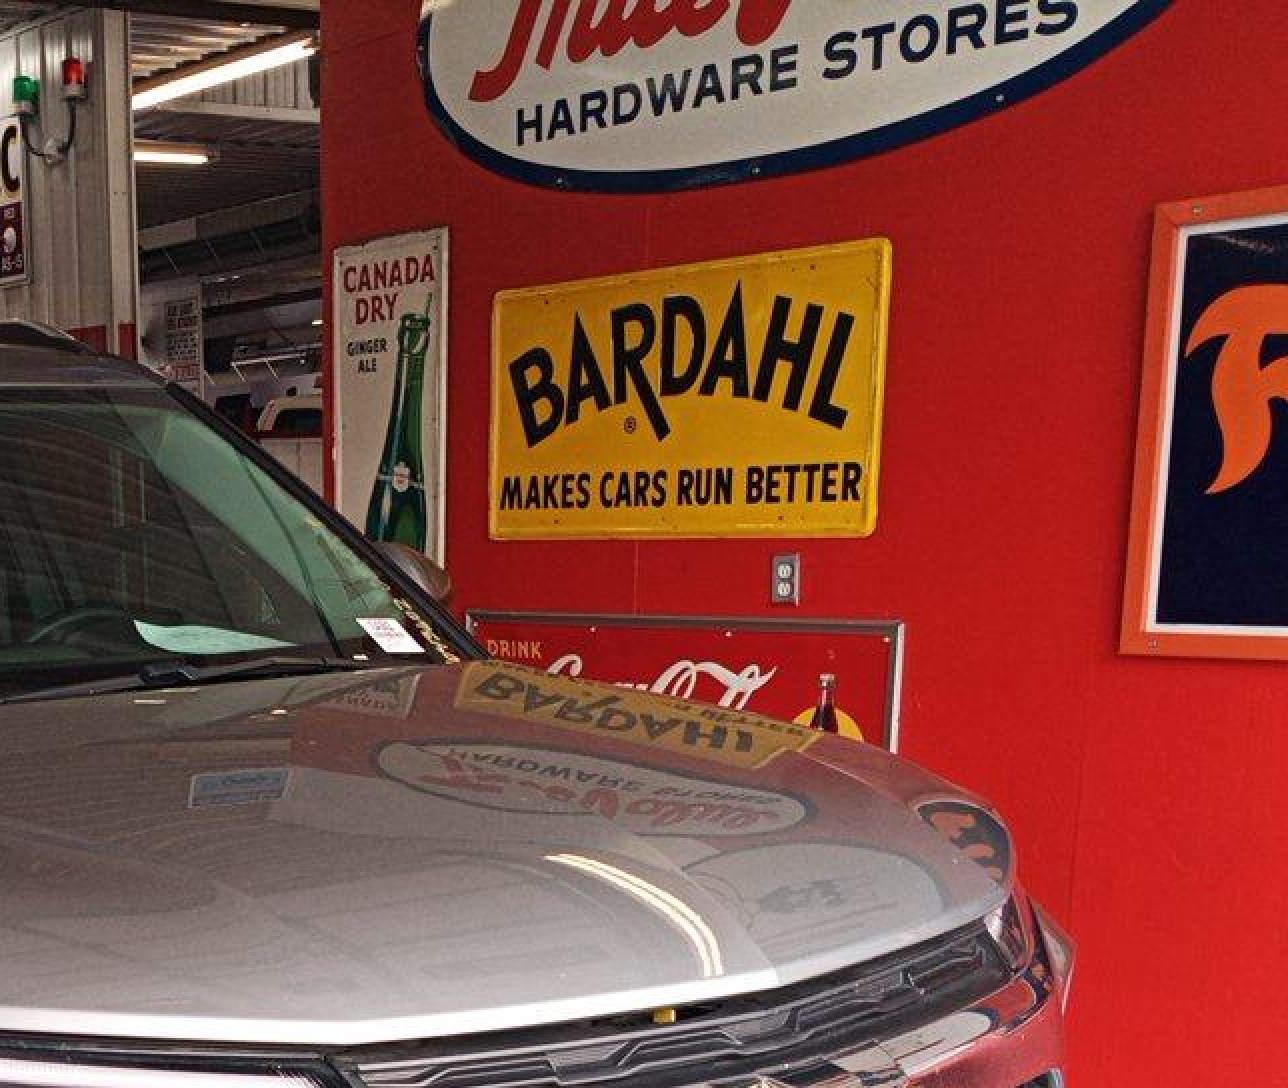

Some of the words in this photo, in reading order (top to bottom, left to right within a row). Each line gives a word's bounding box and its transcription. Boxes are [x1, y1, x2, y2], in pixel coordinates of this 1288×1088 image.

[516, 44, 799, 147] HARDWARE
[822, 0, 1079, 80] STORES
[343, 253, 435, 293] CANADA
[355, 292, 399, 325] DRY
[347, 337, 388, 357] GINGER
[508, 278, 855, 449] BARDAHL
[357, 358, 377, 373] ALE
[499, 473, 592, 511] MAKES
[599, 469, 668, 509] CARS
[676, 467, 734, 507] RUN
[745, 461, 863, 505] BETTER
[487, 639, 541, 659] DRINK
